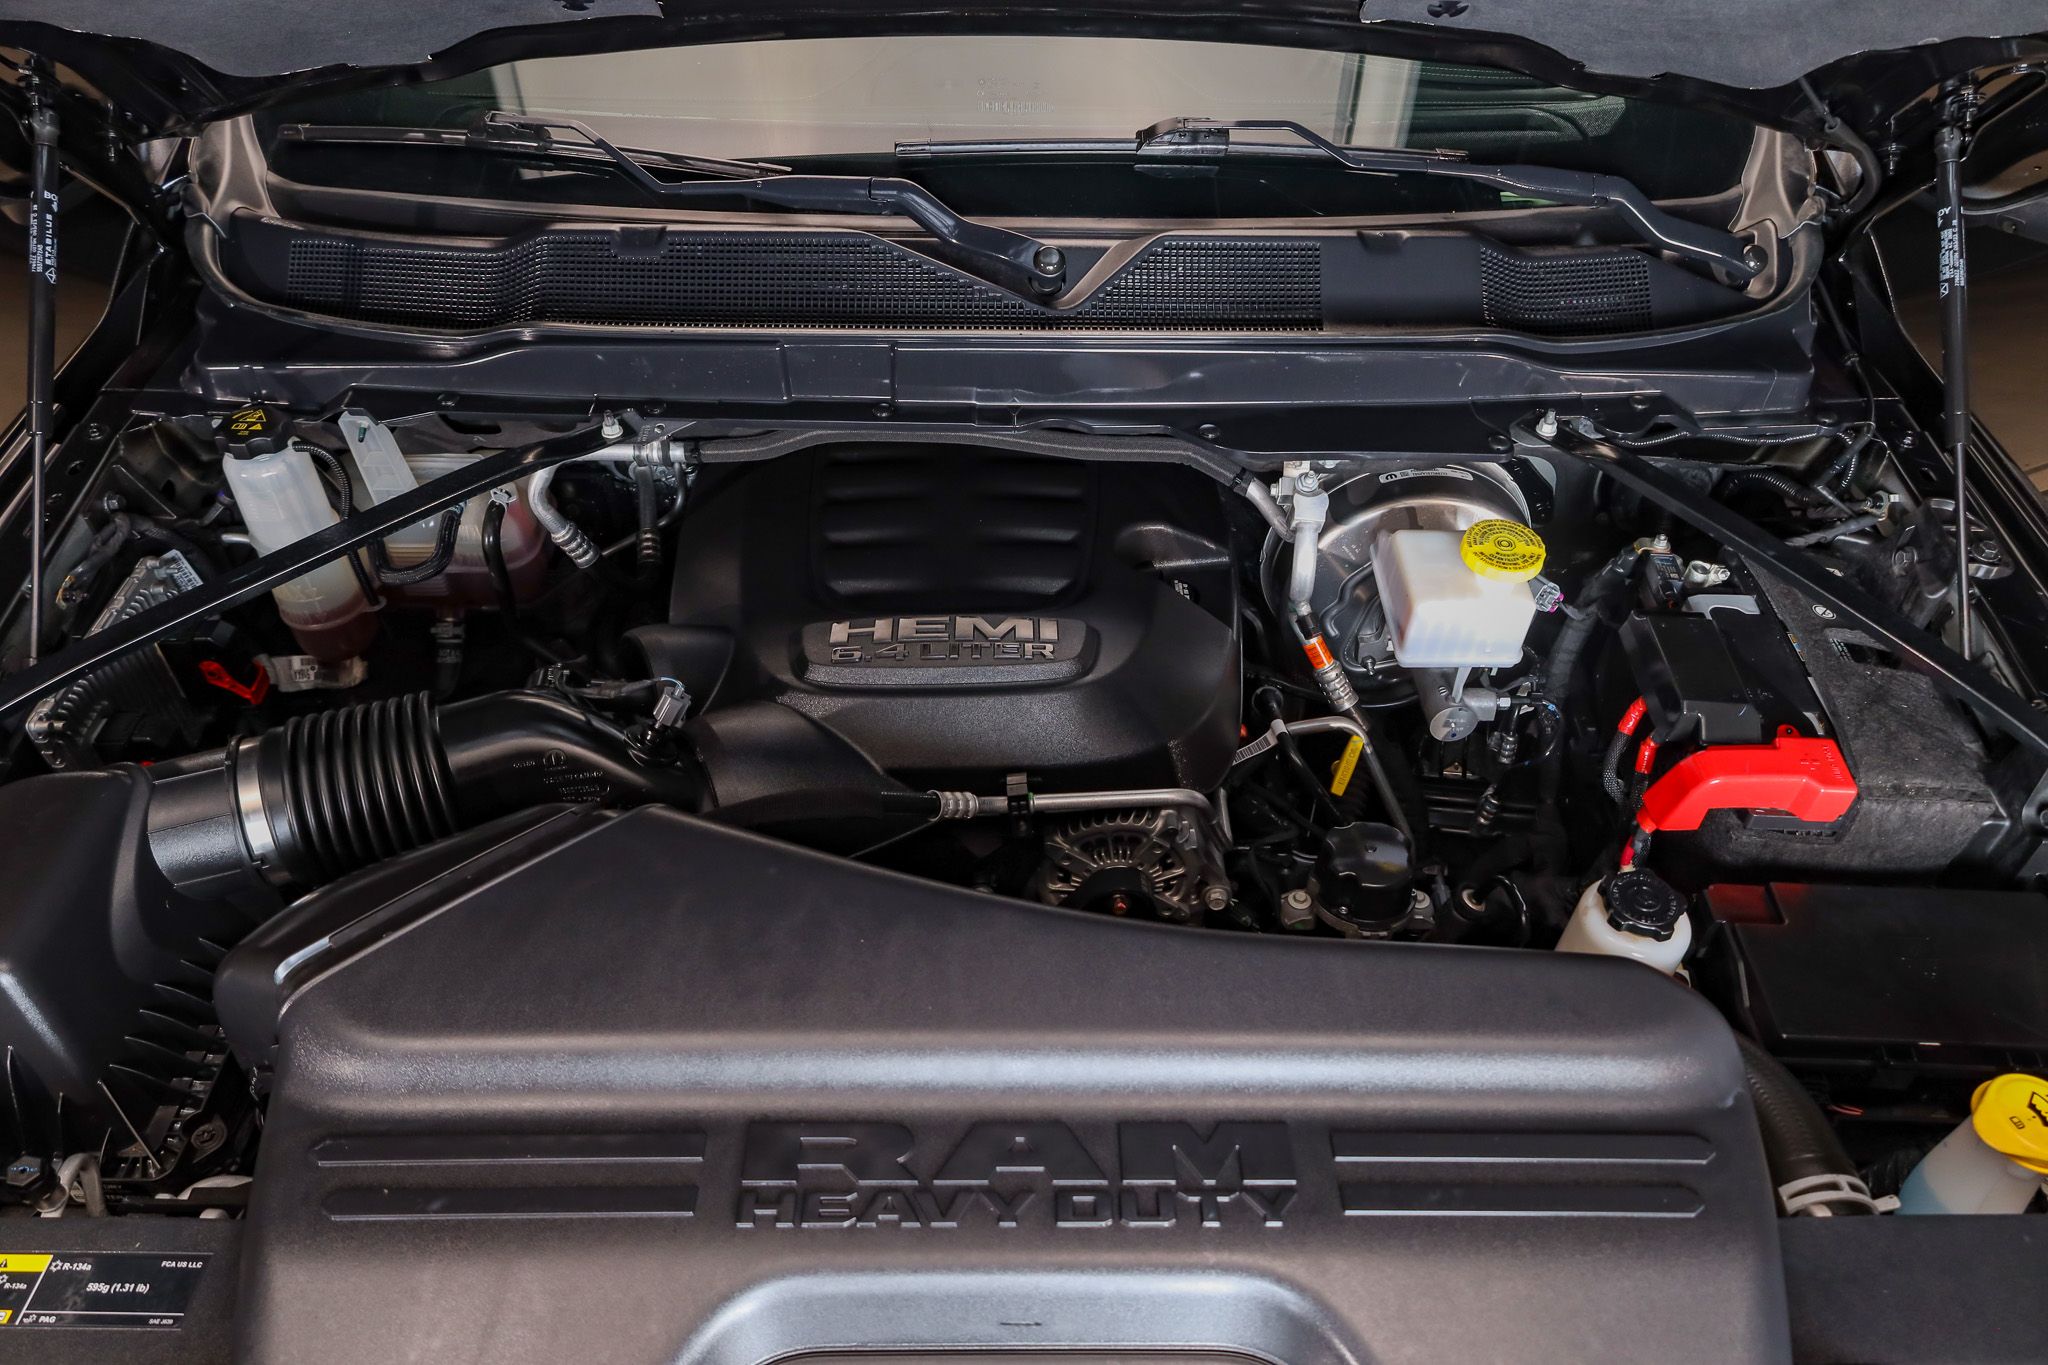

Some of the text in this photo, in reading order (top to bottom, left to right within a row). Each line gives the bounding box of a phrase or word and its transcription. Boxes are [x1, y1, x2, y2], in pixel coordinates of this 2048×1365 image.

[829, 616, 1059, 644] HEMI
[831, 642, 1055, 663] 6.4 LITER
[740, 1119, 1298, 1186] RAM
[735, 1189, 1299, 1228] HEAVY DUTY
[62, 1262, 92, 1271] R-134a
[161, 1260, 203, 1269] FCA US LLC
[86, 1282, 150, 1294] 595g (1.31 lb)
[39, 1315, 56, 1324] PAG
